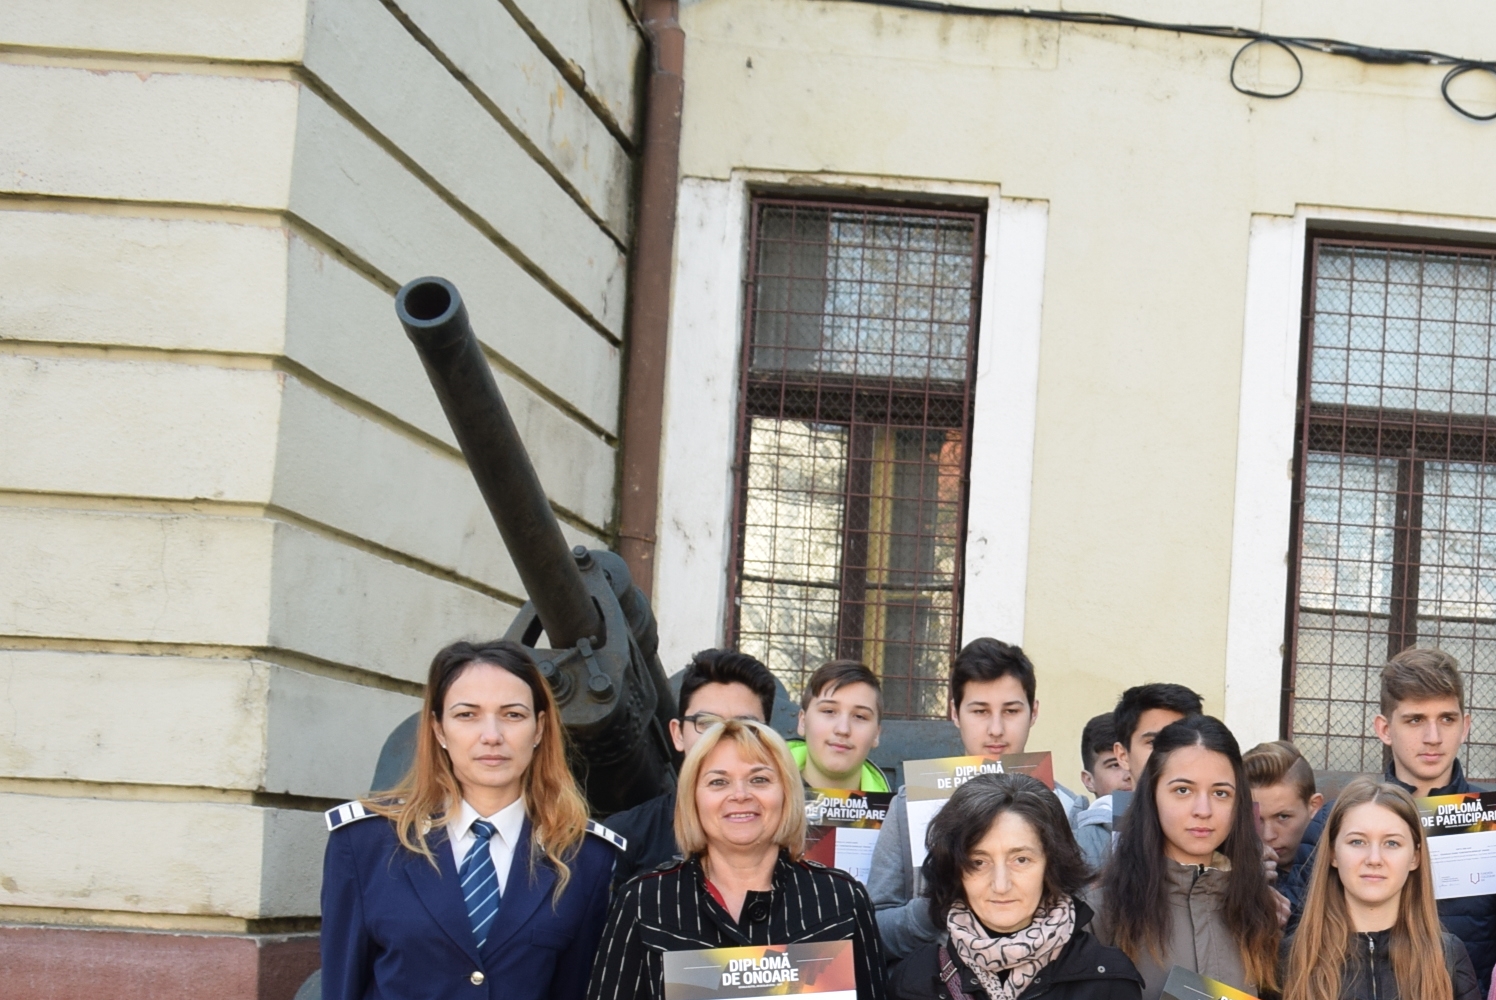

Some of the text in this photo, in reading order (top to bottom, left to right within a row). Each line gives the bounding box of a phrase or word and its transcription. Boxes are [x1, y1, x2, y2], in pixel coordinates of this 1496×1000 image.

[955, 761, 1004, 776] DIPLOMĂ
[937, 778, 952, 789] DE
[823, 797, 868, 809] DIPLOMĂ
[1438, 799, 1483, 815] DIPLOMĂ
[820, 807, 886, 820] PARTICIPARE
[1421, 816, 1434, 827] DE
[729, 953, 791, 972] DIPLOMĂ
[722, 968, 799, 986] DE ONOARE
